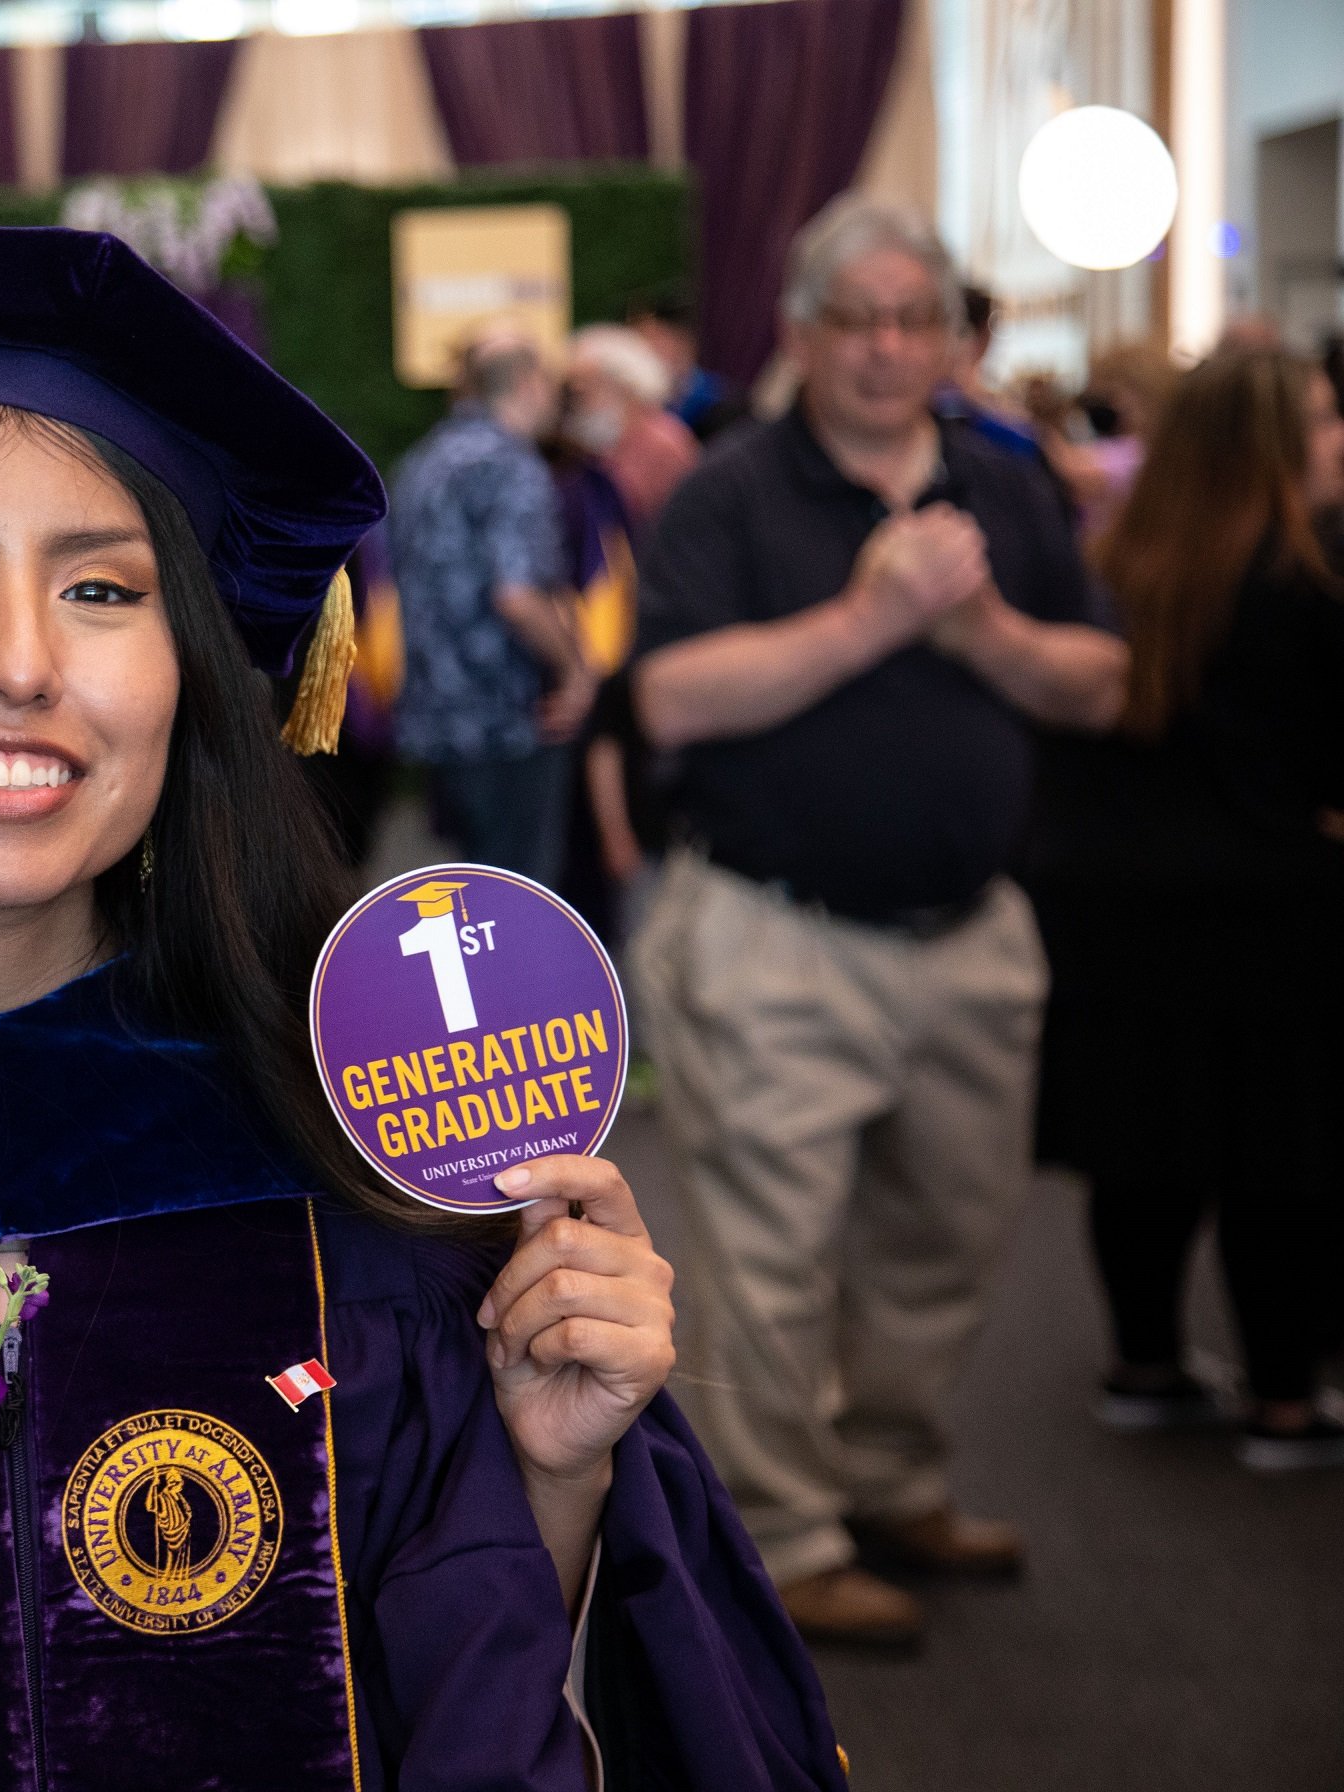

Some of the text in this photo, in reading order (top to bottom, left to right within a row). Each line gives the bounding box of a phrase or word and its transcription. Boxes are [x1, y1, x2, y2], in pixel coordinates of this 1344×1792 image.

[398, 912, 496, 1034] 1ST
[342, 1008, 609, 1111] GENERATION
[376, 1065, 601, 1158] GRADUATE
[422, 1132, 578, 1181] UNIVERSITY AT ALBANY
[67, 1414, 277, 1529] SAPIENTIA ET SUA ET DOCENDI CAUSA
[87, 1438, 256, 1570] UNIVERSITY AT ALBANY
[71, 1539, 276, 1629] STATE UNIVERSITY OF NEW YORK
[143, 1582, 203, 1606] 1844
